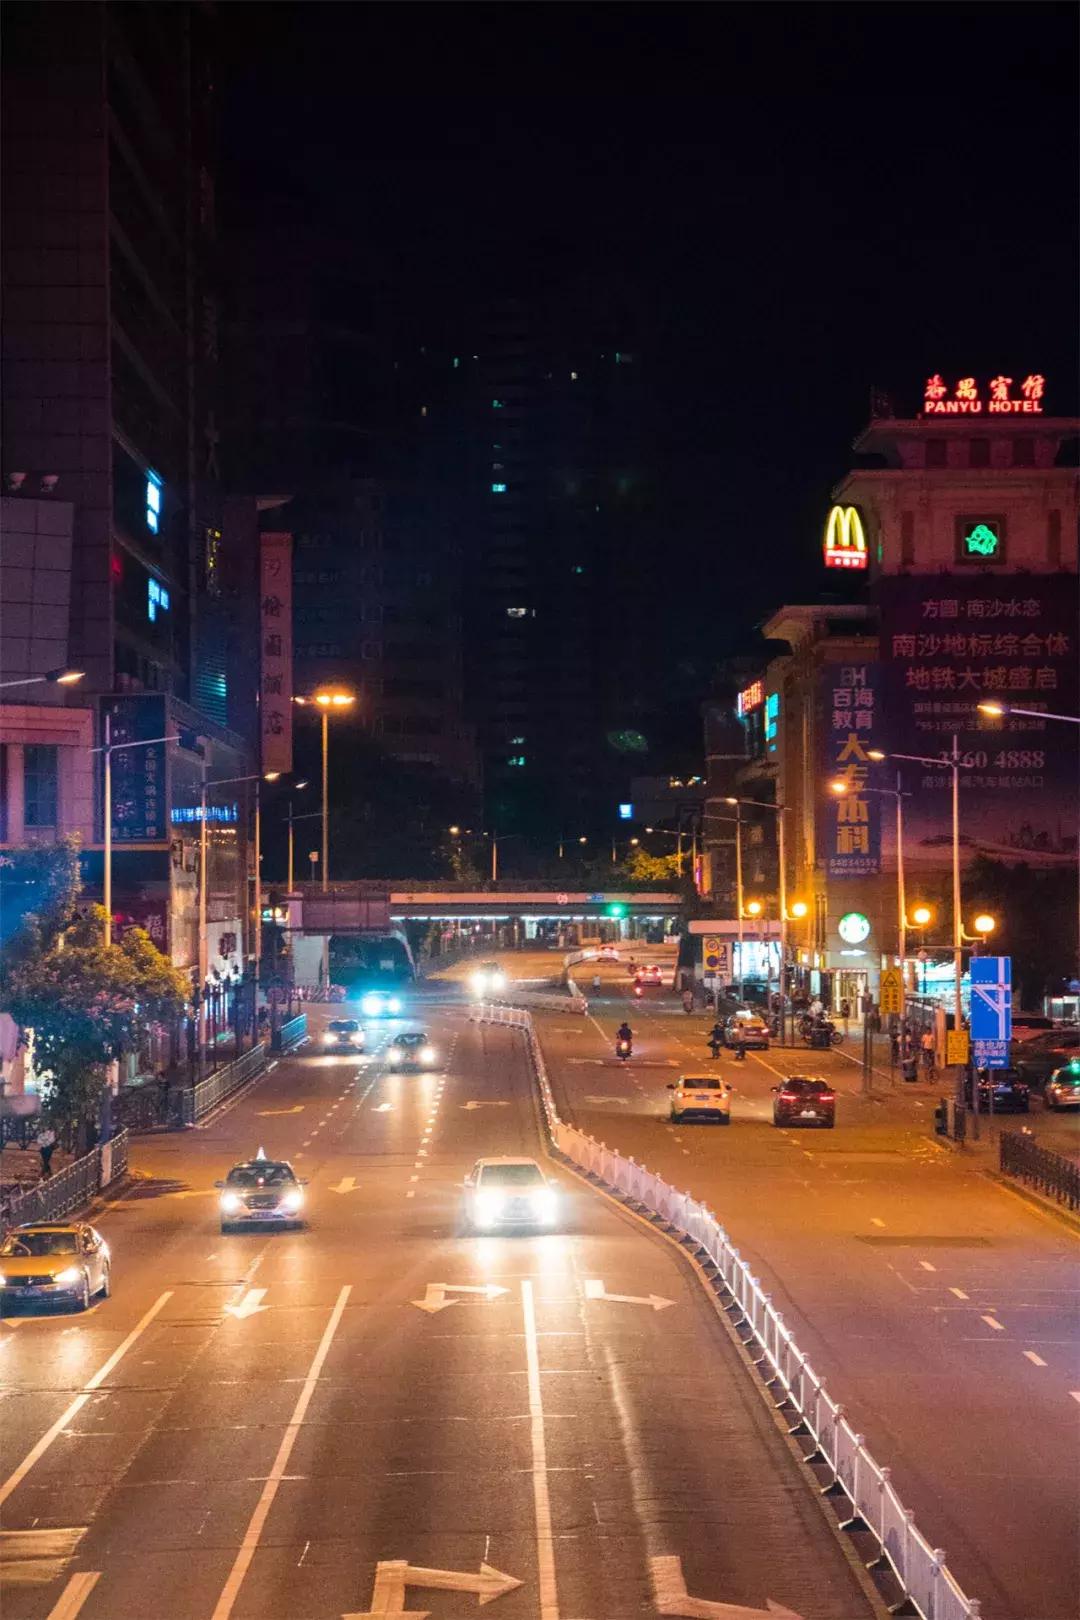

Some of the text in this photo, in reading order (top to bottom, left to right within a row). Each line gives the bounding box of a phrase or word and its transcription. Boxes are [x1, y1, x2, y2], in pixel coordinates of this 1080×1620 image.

[925, 400, 1043, 413] PANYU HOTEL
[832, 687, 875, 707] 百海
[832, 709, 874, 730] 教育
[993, 750, 1045, 768] 4888
